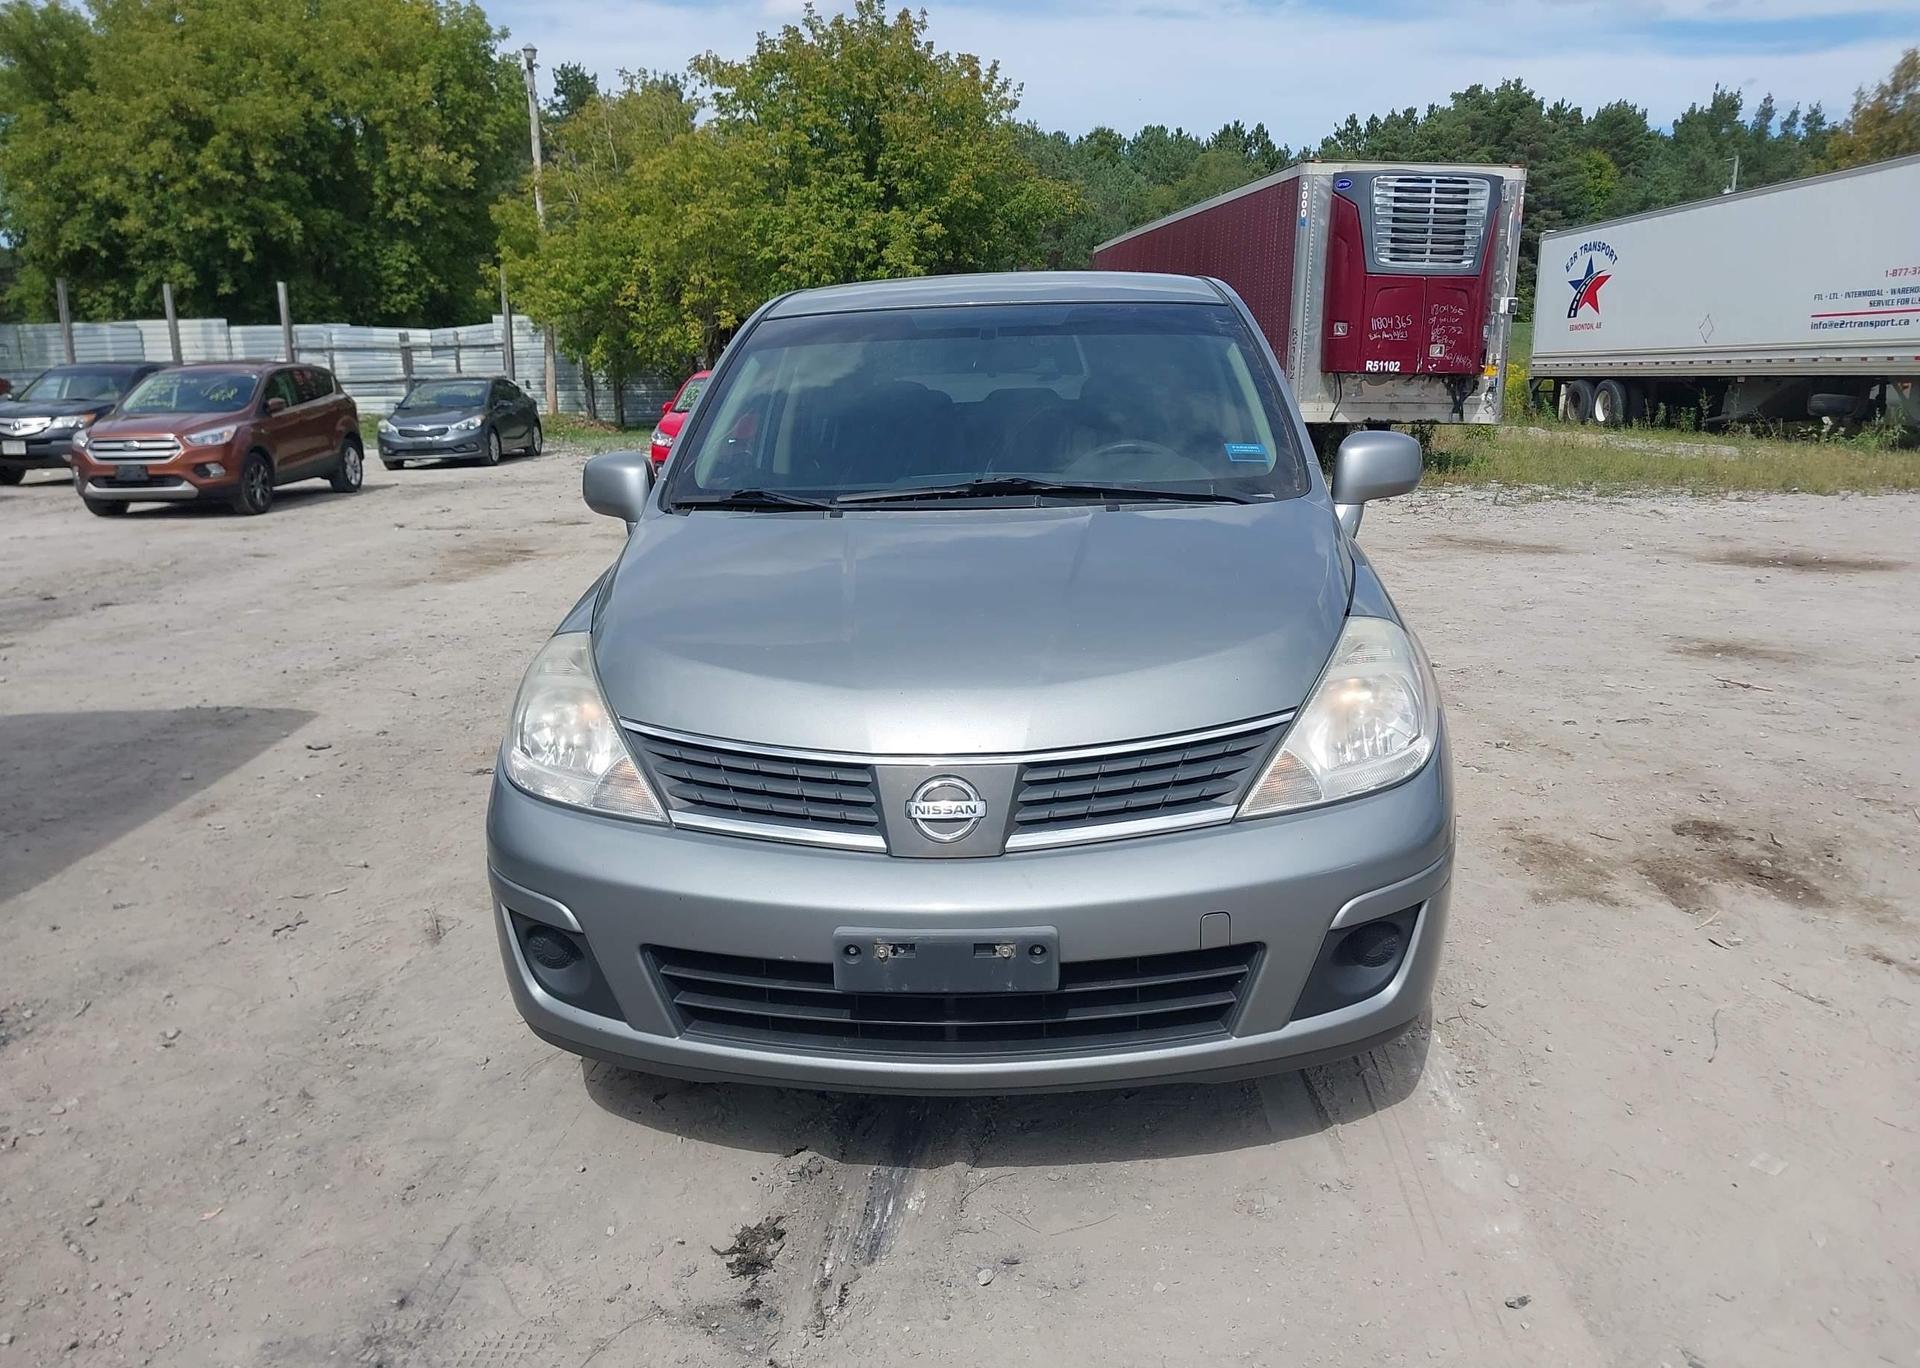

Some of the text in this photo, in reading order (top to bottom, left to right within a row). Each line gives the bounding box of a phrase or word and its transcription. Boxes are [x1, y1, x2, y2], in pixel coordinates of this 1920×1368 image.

[1565, 241, 1618, 273] E2R TRANSPORT
[1828, 292, 1839, 301] LTL
[1845, 289, 1883, 299] INTERMODAL
[1868, 299, 1895, 307] SERVICE
[1896, 297, 1910, 306] FOR
[1811, 319, 1910, 329] info@e2rtransport.ca
[1366, 361, 1400, 371] R51102
[914, 804, 977, 815] NISSAN
